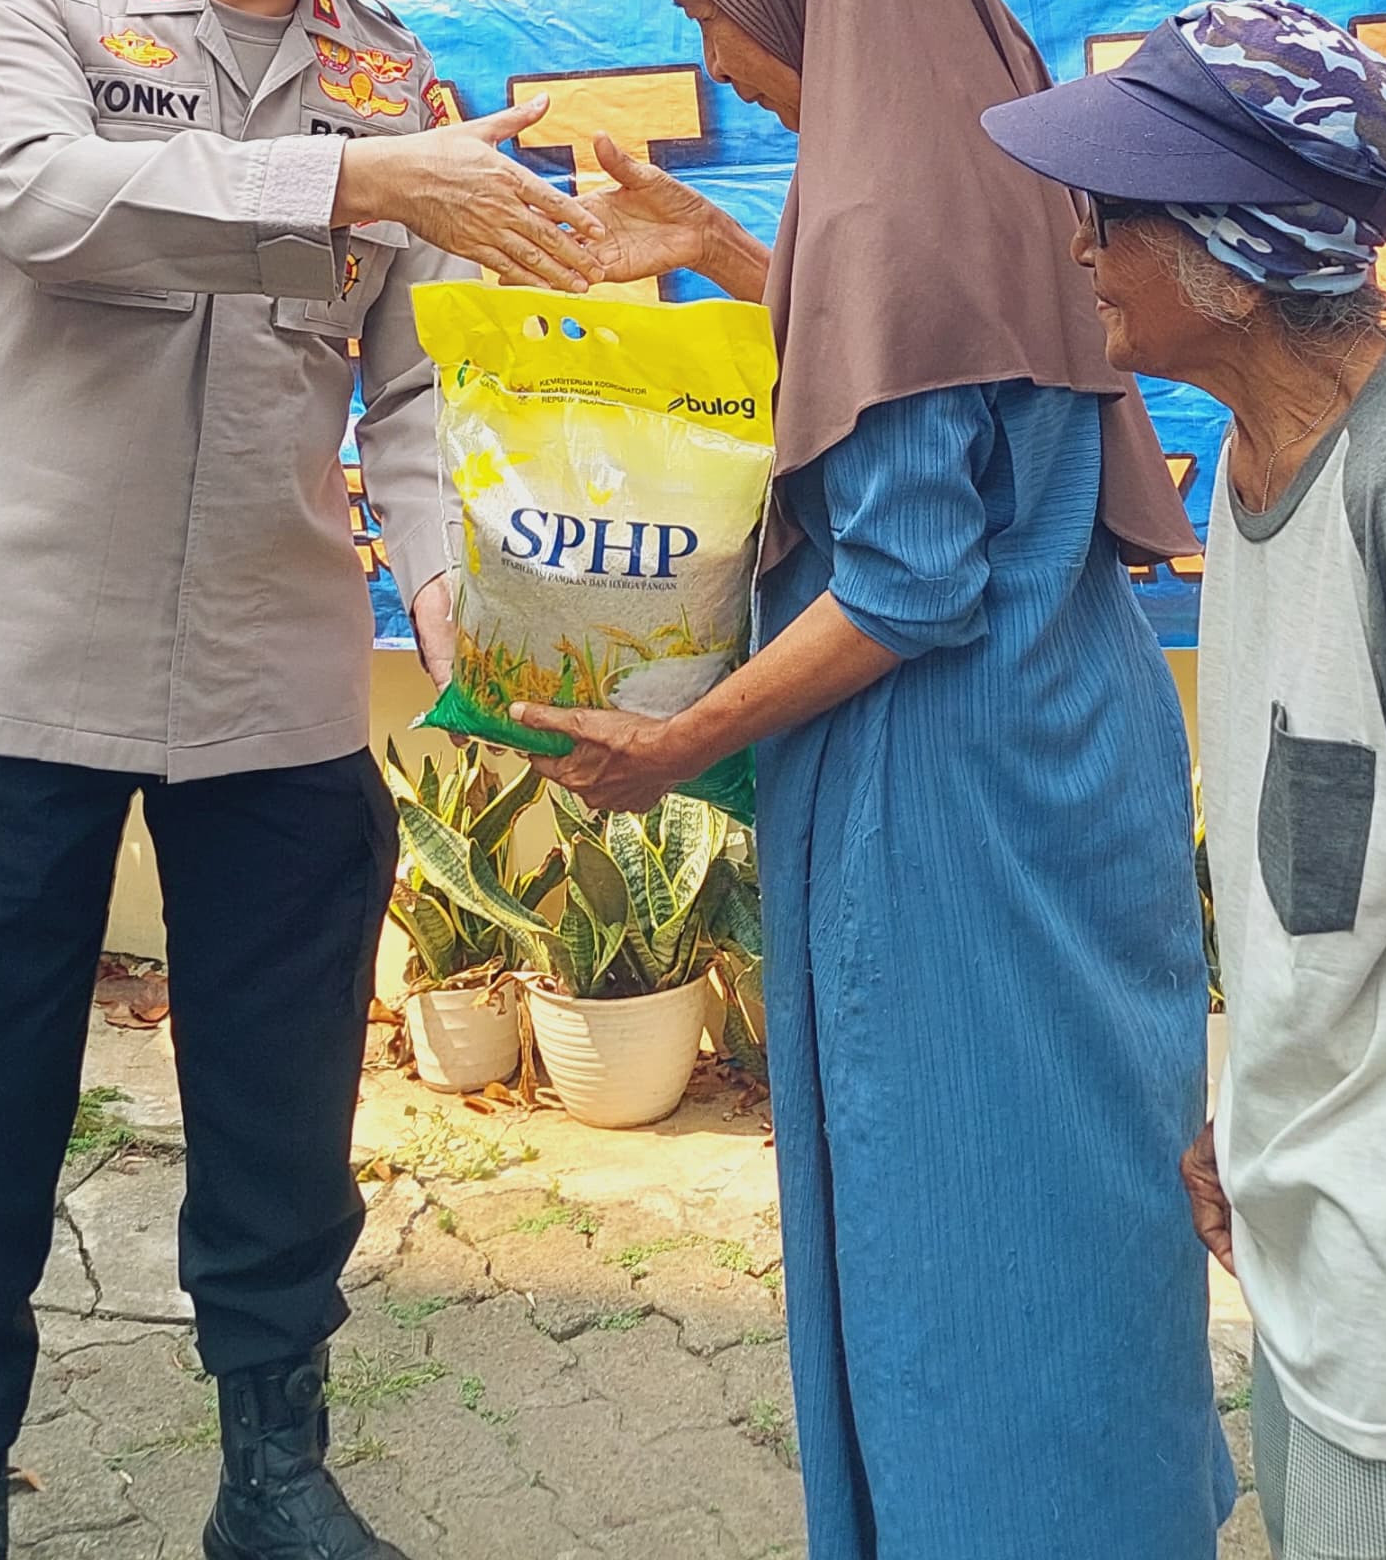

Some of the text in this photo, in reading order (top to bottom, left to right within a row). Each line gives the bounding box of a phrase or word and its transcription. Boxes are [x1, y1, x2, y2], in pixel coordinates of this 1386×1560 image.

[88, 79, 201, 122] YONKY
[685, 392, 756, 419] bulog
[500, 507, 699, 579] SPHP
